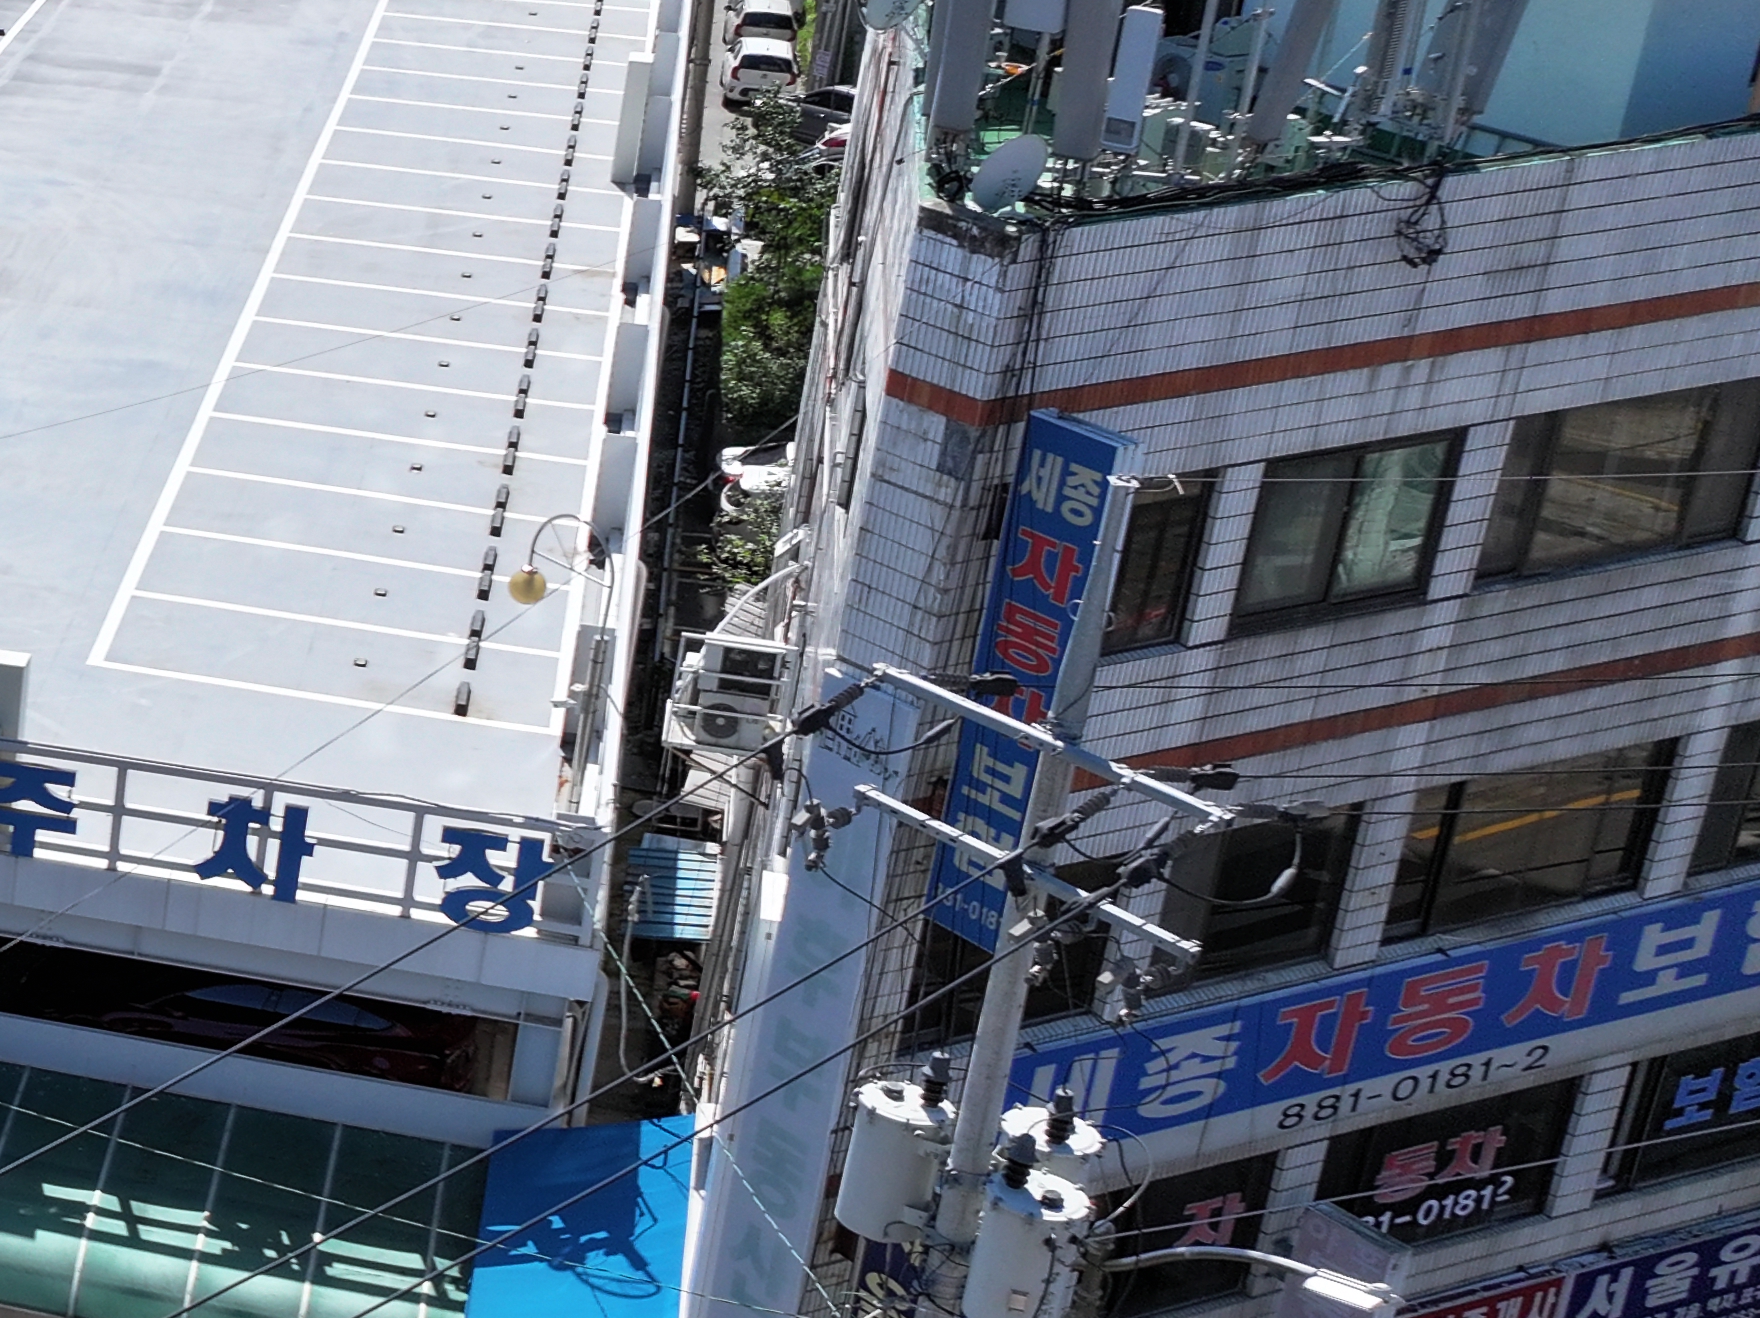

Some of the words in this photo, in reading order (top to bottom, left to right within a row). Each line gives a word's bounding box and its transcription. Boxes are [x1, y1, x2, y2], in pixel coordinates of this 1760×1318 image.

[1020, 447, 1103, 527] 세종
[989, 527, 1082, 752] 자동차
[1260, 934, 1613, 1084] 자동차
[1276, 1044, 1550, 1130] 881-0181~2
